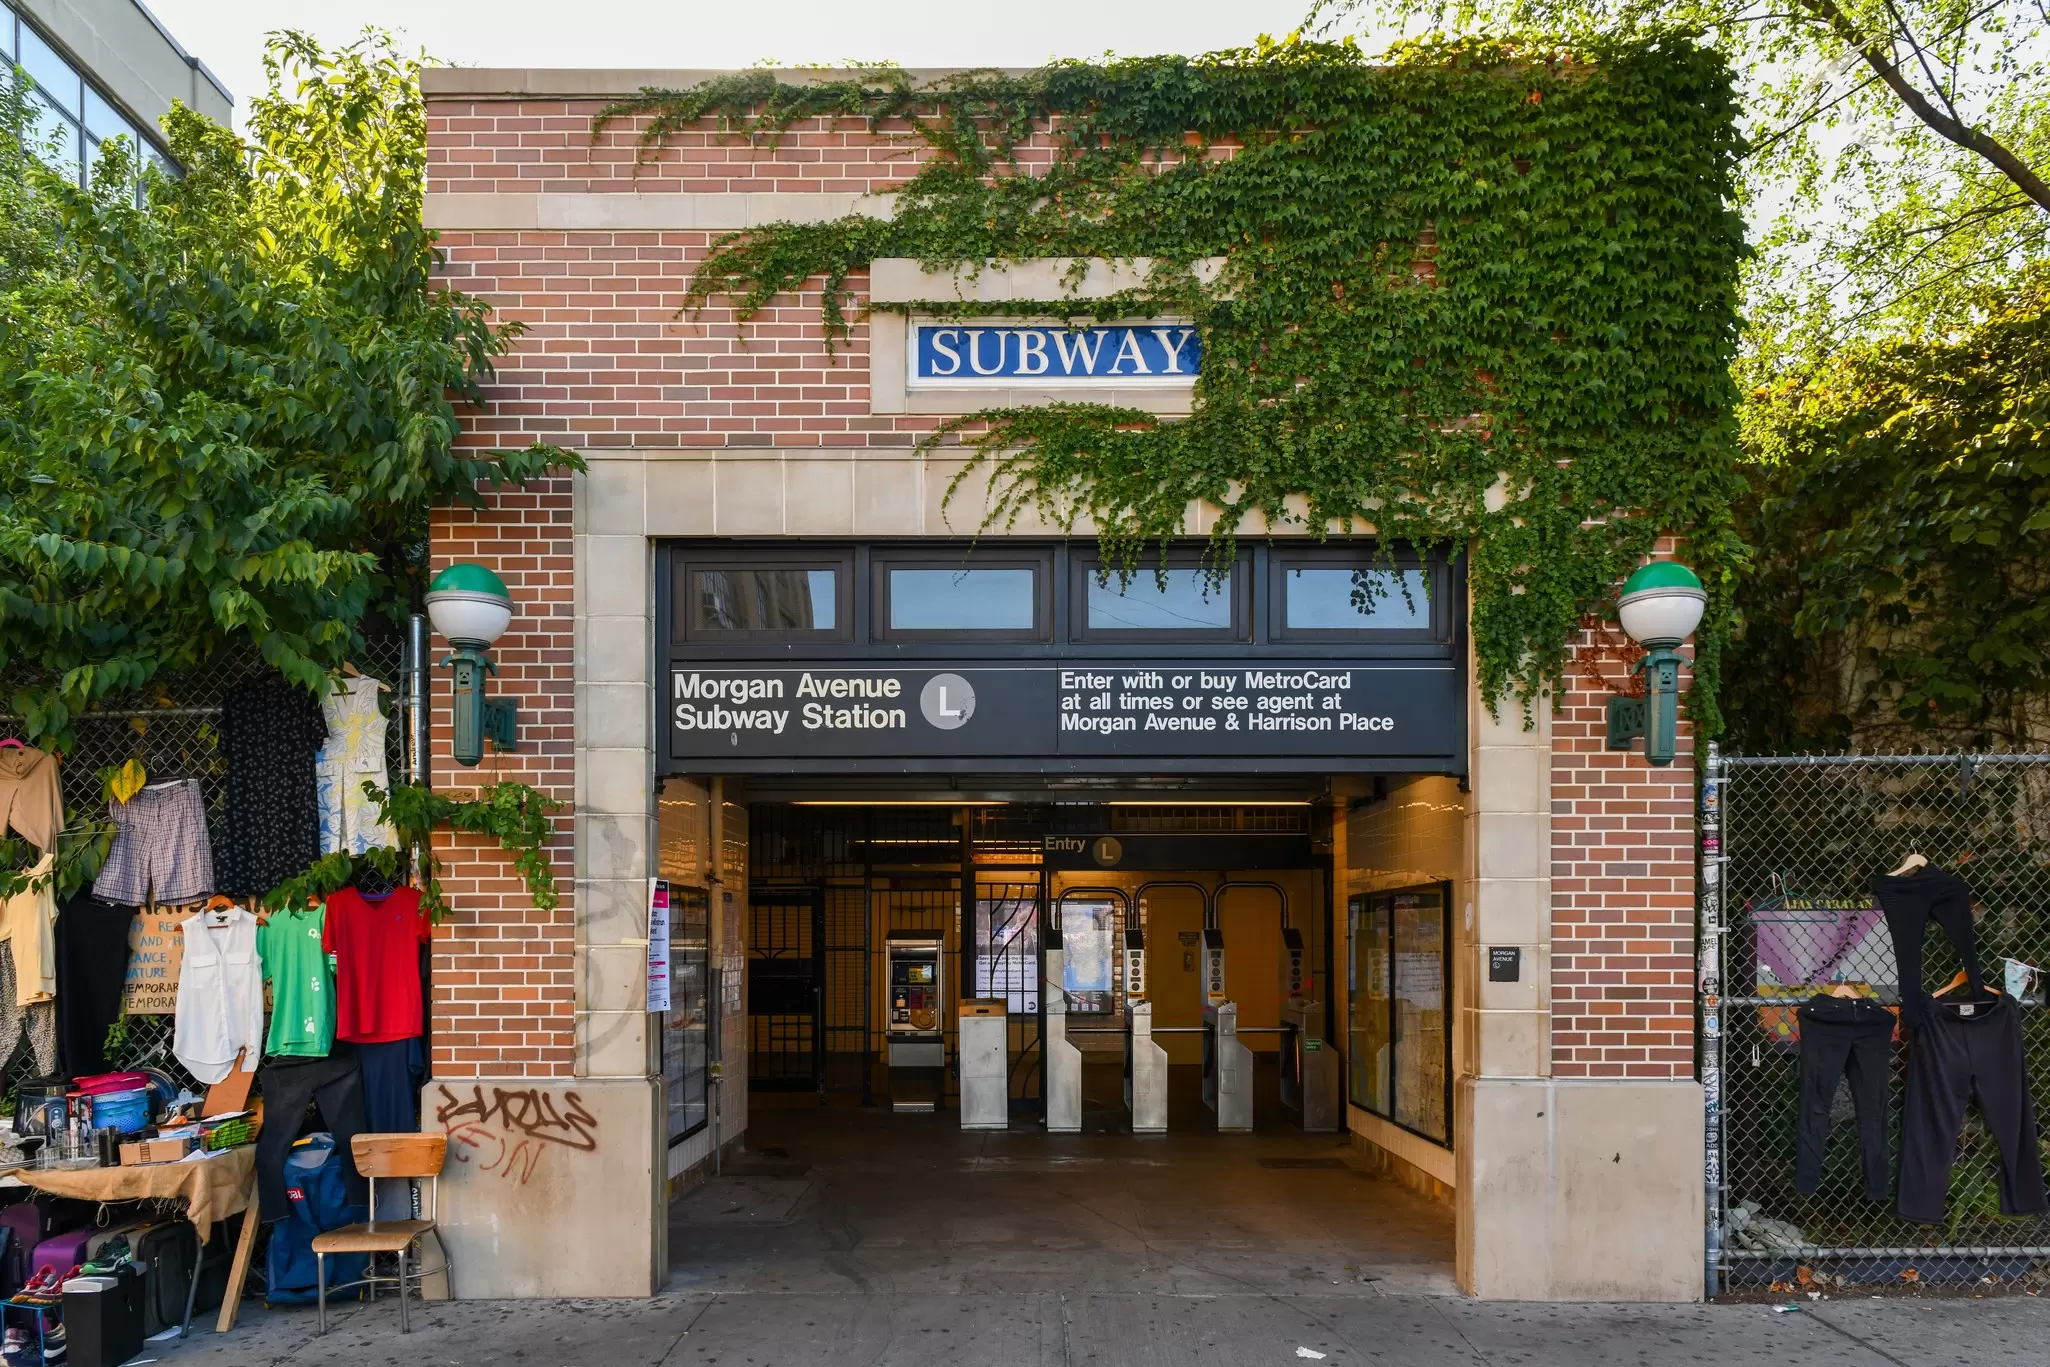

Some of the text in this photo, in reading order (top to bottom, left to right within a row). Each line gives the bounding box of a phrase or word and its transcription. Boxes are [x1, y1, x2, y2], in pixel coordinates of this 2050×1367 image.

[932, 328, 1194, 375] SUBWAY
[674, 673, 901, 704] Morgan Avenue
[1061, 671, 1351, 693] Enter with or buy MetroCard
[940, 686, 961, 716] L
[1061, 692, 1342, 714] at all times or see agent at
[675, 703, 906, 734] Subway Station
[1061, 713, 1394, 735] Morgan Avenue & Harrison Place
[1045, 837, 1086, 853] Entry
[1102, 843, 1113, 860] L
[140, 936, 164, 947] AND
[130, 952, 172, 965] ANCE,
[123, 997, 177, 1009] TEMPORA
